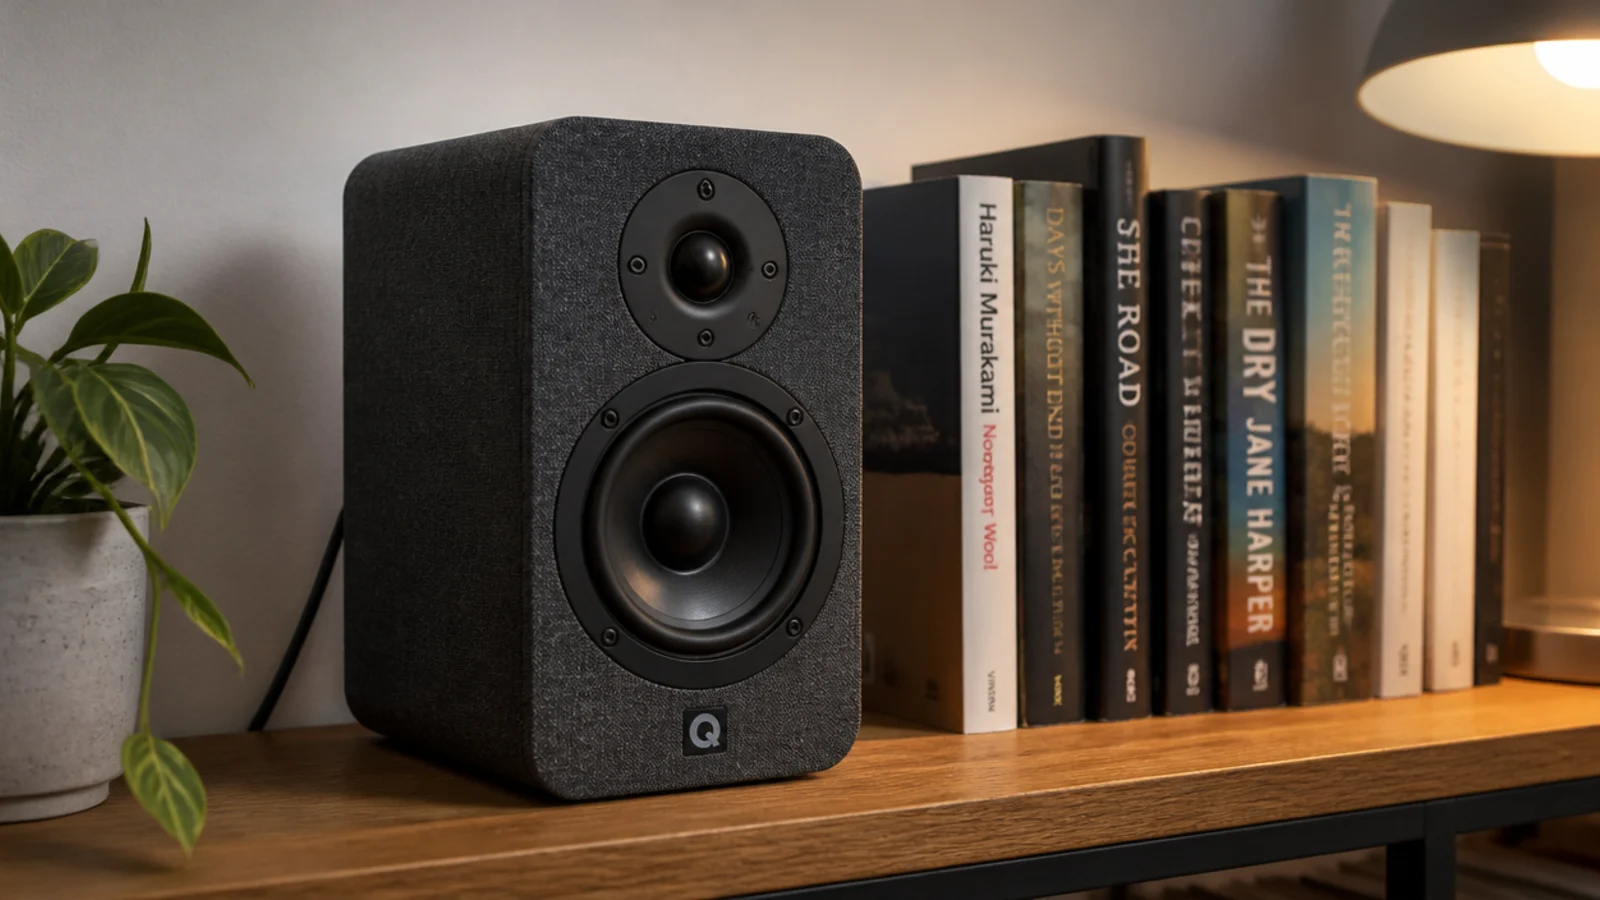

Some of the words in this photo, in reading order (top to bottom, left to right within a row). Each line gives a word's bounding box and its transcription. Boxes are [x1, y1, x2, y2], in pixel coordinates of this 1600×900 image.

[979, 203, 998, 283] Haruki
[1046, 207, 1065, 273] DAYS
[1245, 255, 1273, 316] THE
[980, 293, 1000, 414] Murakami
[1117, 303, 1142, 407] ROAD
[1242, 328, 1277, 404] DRY
[1245, 417, 1274, 496] JANE
[1246, 508, 1275, 634] HARPER
[689, 712, 721, 749] Q
